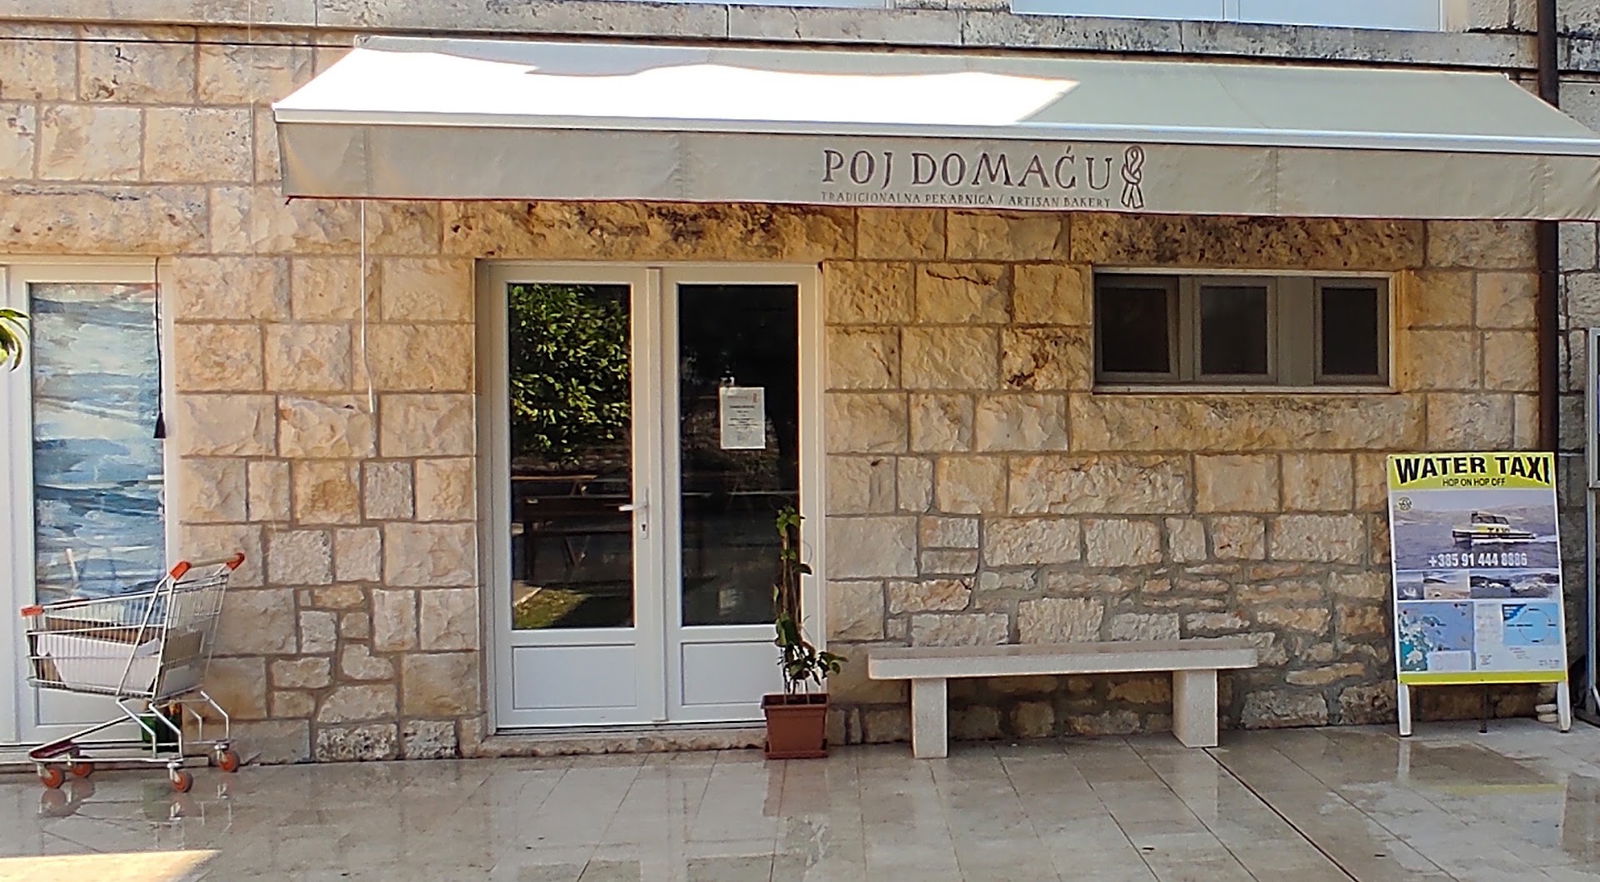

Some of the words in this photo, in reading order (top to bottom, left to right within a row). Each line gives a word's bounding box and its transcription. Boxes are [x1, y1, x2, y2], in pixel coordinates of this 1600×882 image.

[822, 149, 893, 189] POJ
[911, 145, 1113, 190] DOMAĆU
[821, 191, 921, 204] TRADICIONALNA
[925, 193, 994, 205] PEKARNICA
[1009, 195, 1059, 207] ARTISAN
[1063, 196, 1111, 208] BAKERY
[1395, 456, 1487, 485] WATER
[1494, 456, 1551, 485] TAXI
[1442, 478, 1460, 487] HOP
[1460, 478, 1472, 487] ON
[1474, 478, 1490, 486] HOP
[1491, 478, 1506, 486] OFF
[1428, 553, 1459, 568] +385
[1461, 552, 1475, 567] 91
[1477, 552, 1499, 566] 444
